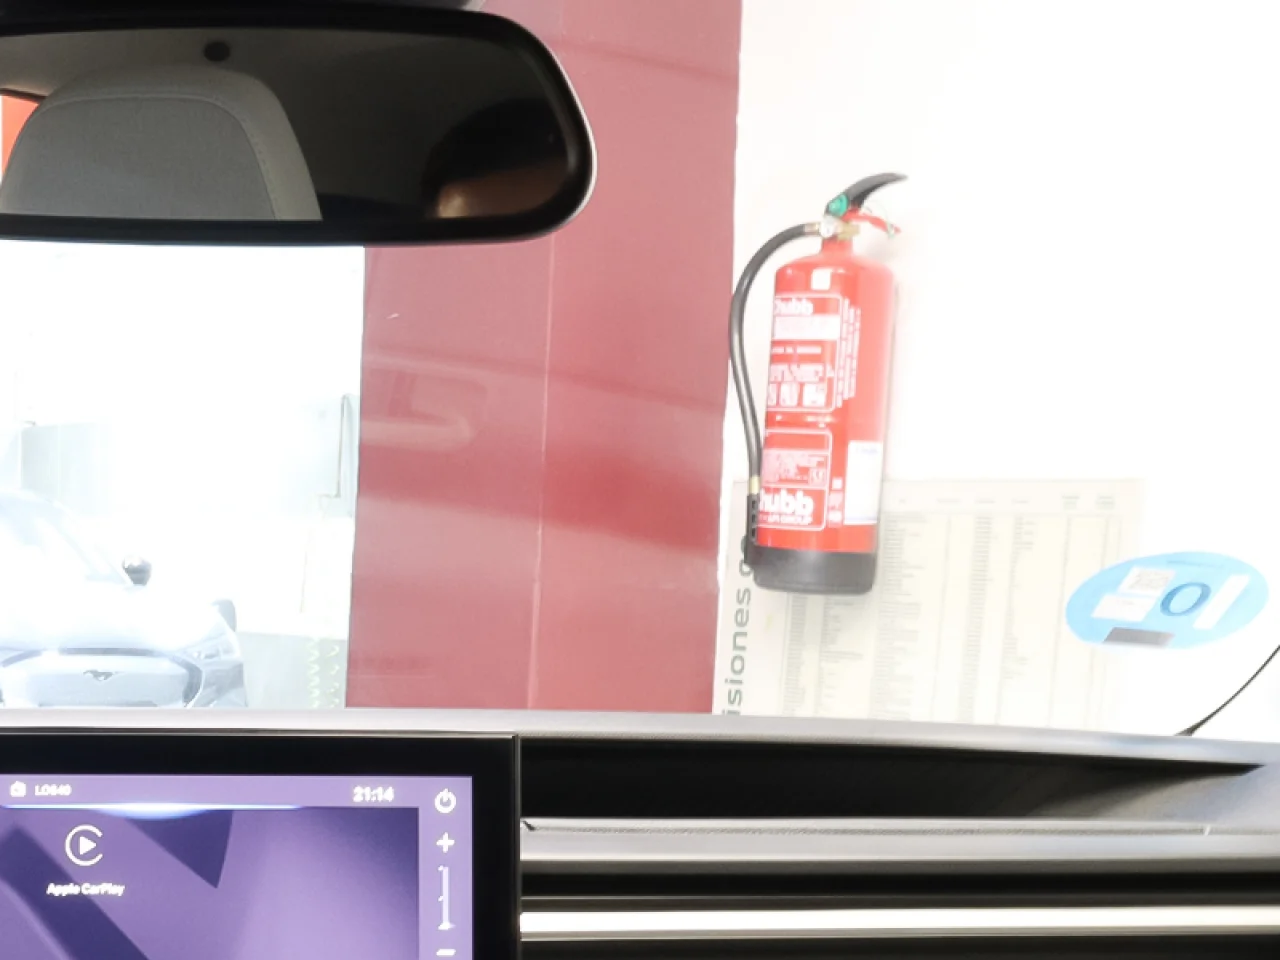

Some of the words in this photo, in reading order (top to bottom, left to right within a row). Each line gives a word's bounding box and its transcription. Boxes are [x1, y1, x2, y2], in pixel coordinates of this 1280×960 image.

[759, 488, 814, 515] hubb
[353, 786, 394, 803] 21:14
[46, 883, 80, 896] Apple
[81, 883, 125, 896] CarPlay
